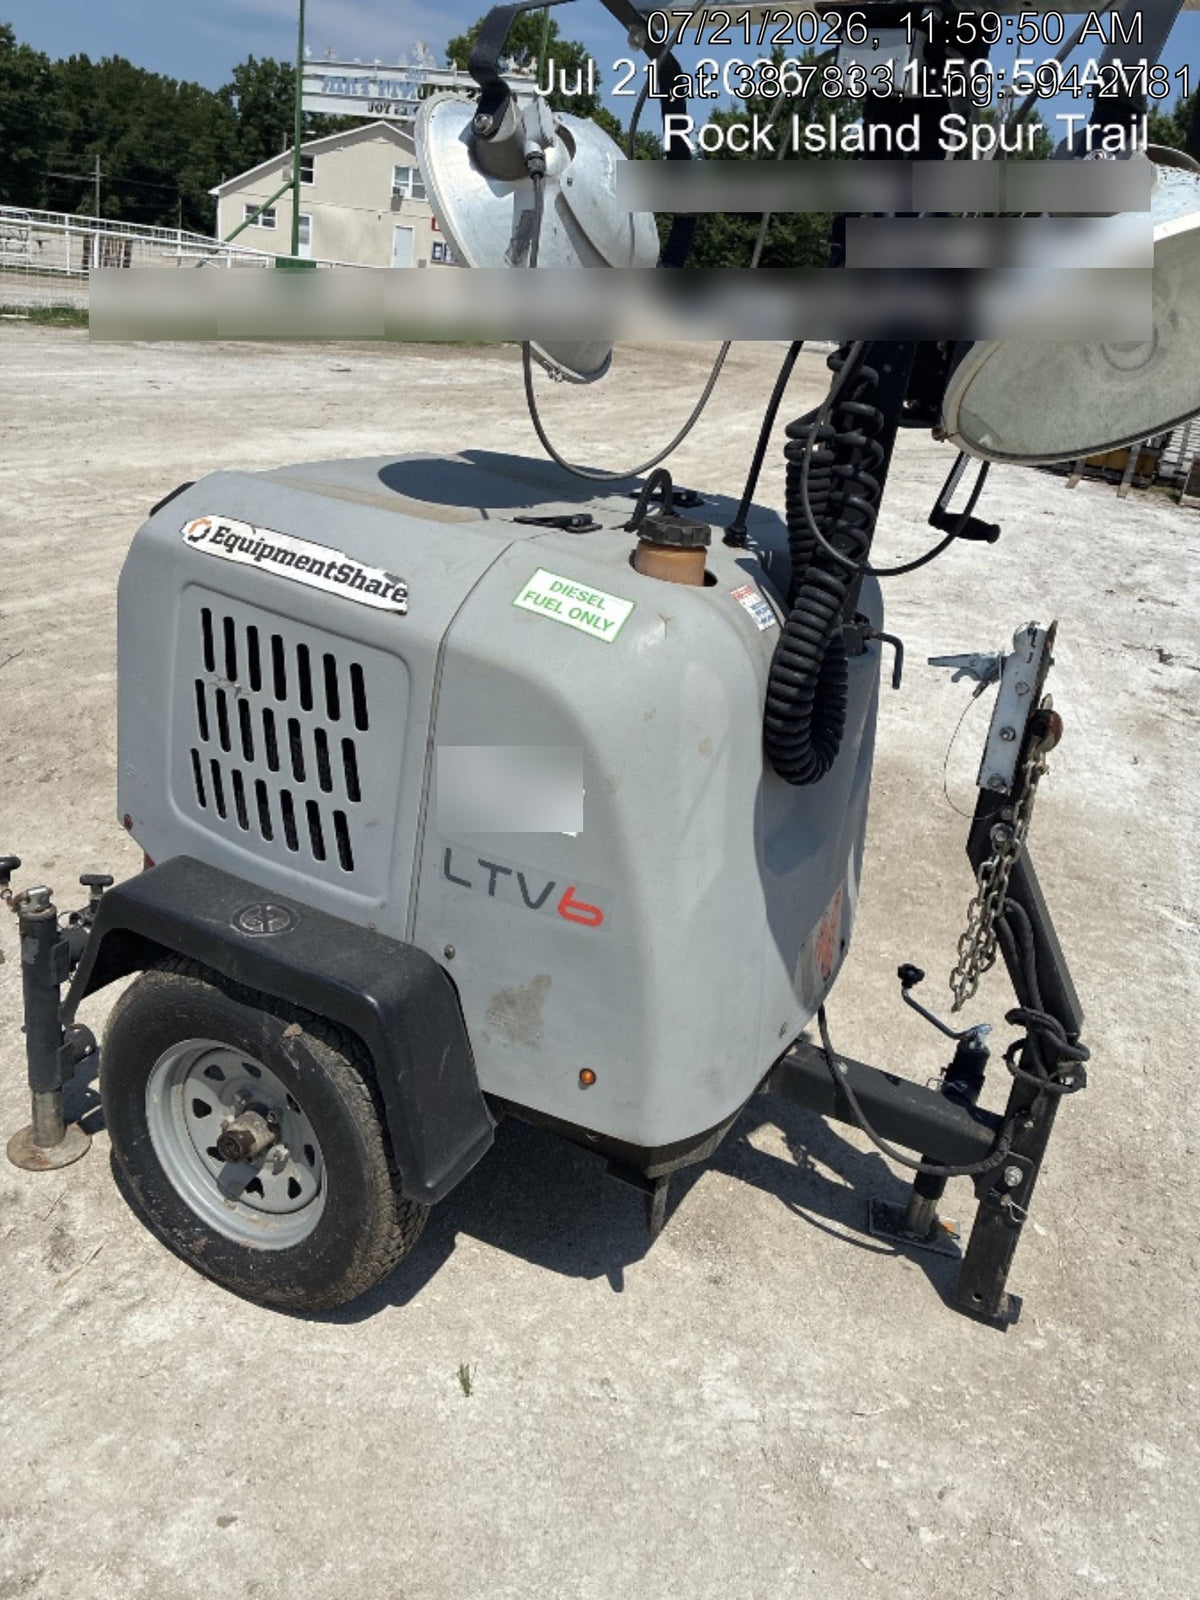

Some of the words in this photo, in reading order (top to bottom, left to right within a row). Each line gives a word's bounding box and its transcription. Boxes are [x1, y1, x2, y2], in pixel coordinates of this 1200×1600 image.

[208, 525, 408, 604] EquipmentShare
[549, 579, 606, 611] DIESEL
[522, 590, 563, 615] FUEL
[568, 605, 616, 633] ONLY
[444, 847, 604, 927] LTV6
